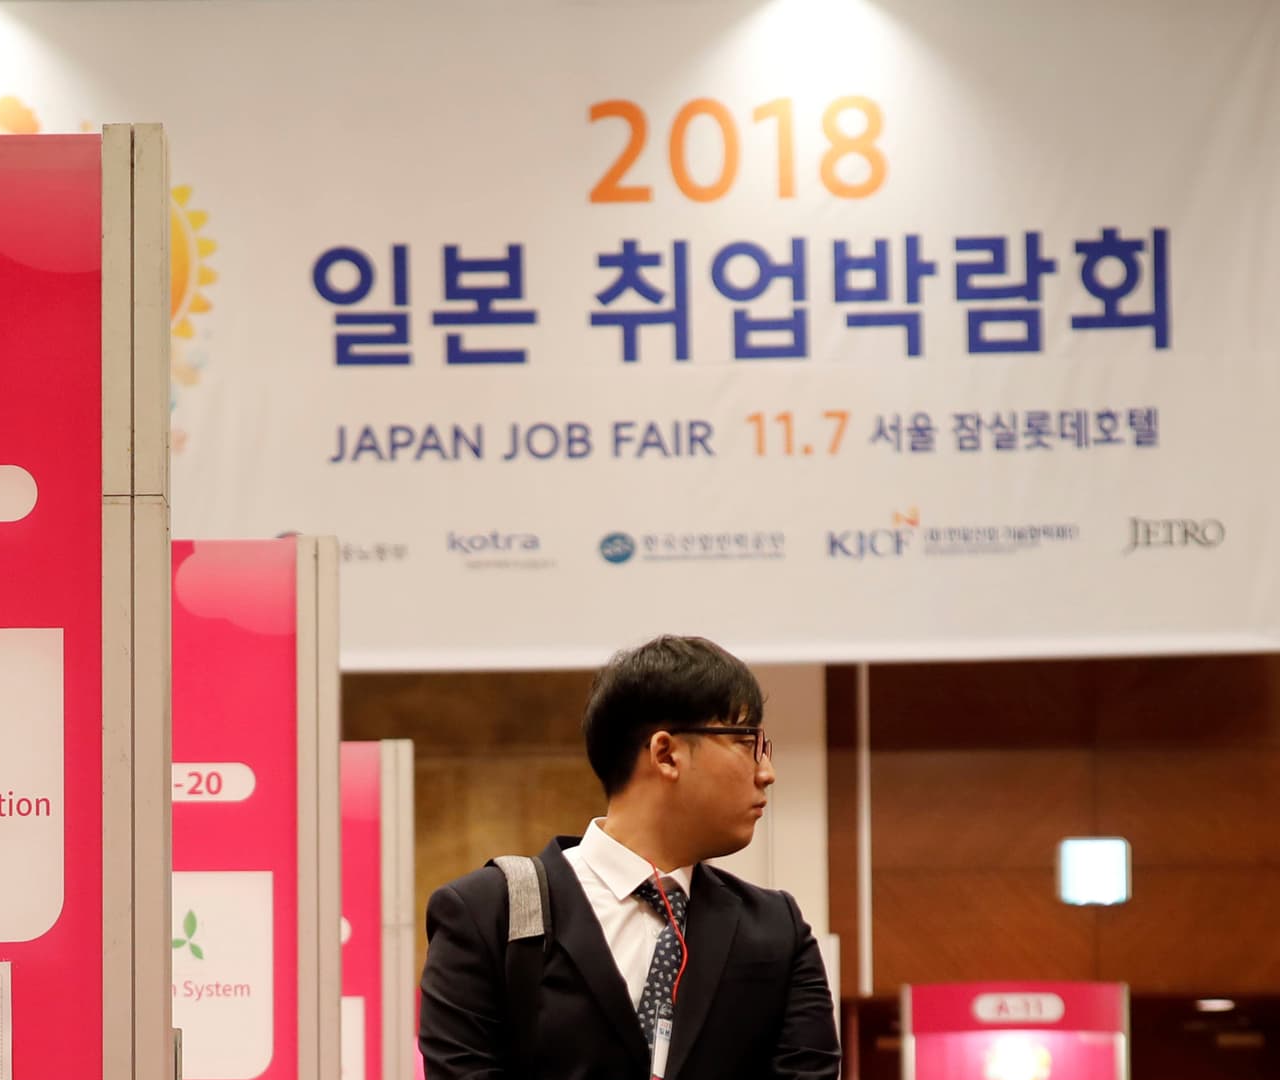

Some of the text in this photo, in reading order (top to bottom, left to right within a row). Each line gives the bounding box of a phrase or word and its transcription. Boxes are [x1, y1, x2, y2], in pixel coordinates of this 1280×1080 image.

[588, 96, 887, 204] 2018
[312, 228, 1171, 366] 일본 취업박람회
[328, 407, 1160, 463] JAPAN JOB FAIR 11.7 서울 잠실롯데호텔
[1121, 516, 1226, 558] JETRO
[173, 771, 223, 795] -20
[184, 980, 251, 1001] System
